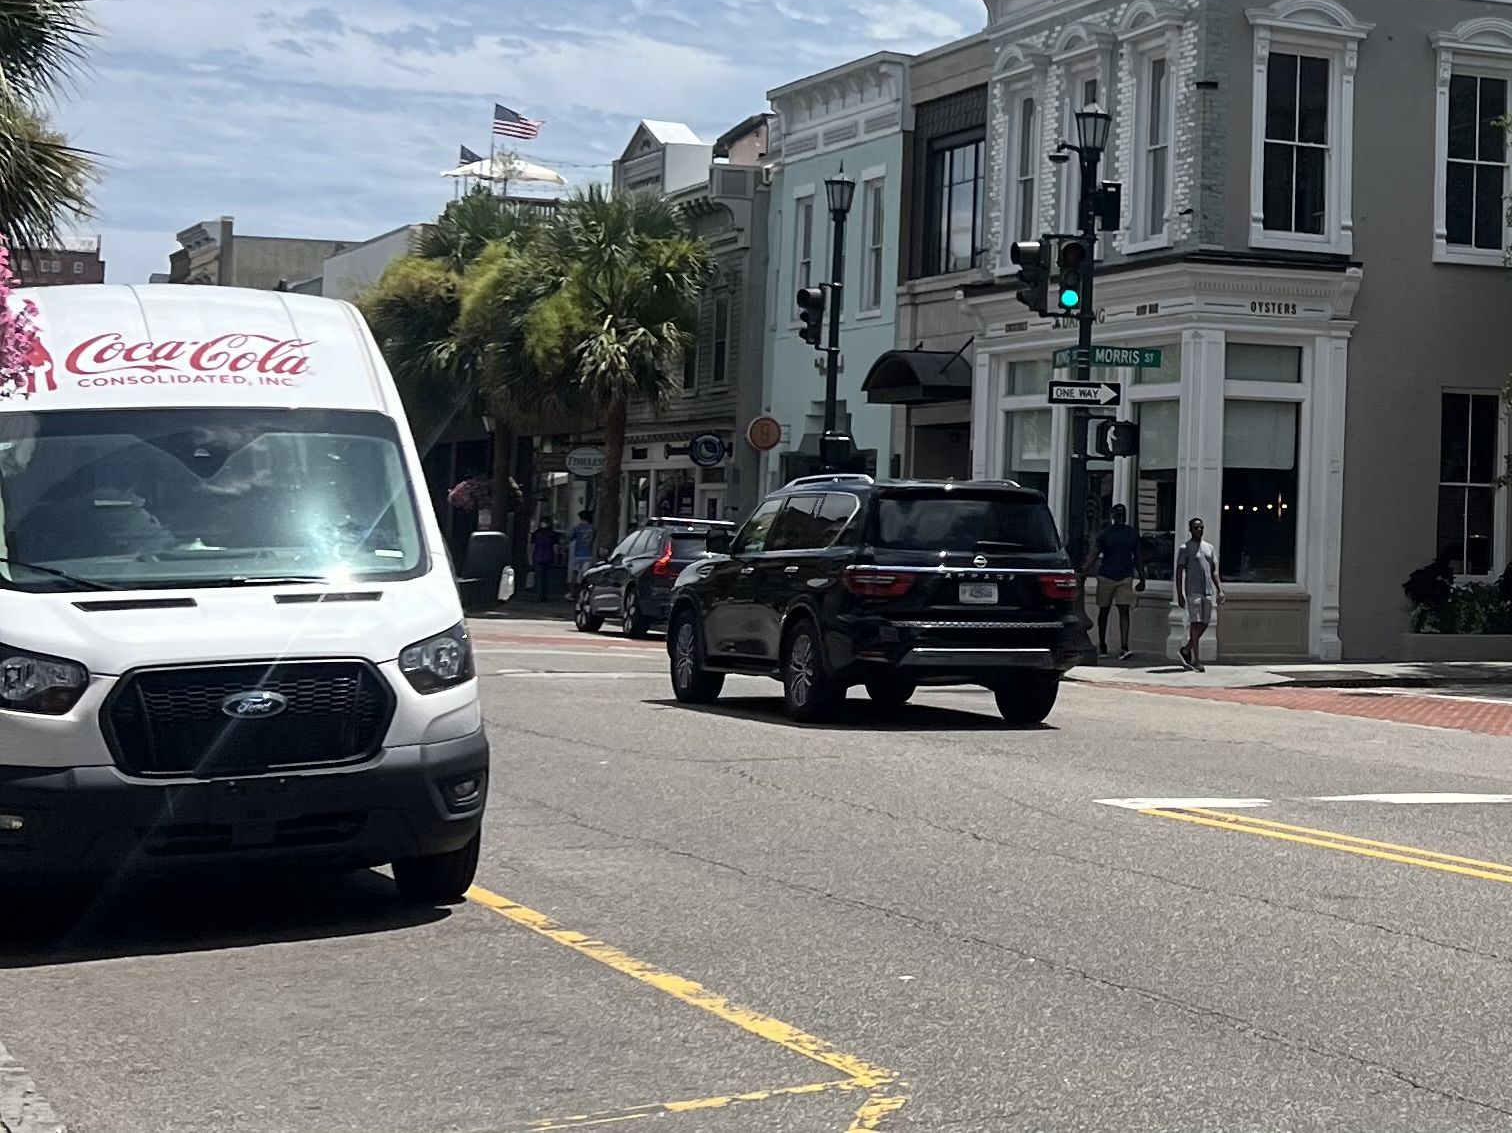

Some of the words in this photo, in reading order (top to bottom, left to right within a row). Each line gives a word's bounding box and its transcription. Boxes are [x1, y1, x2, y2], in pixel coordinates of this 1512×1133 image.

[1250, 301, 1297, 315] OYSTERS
[65, 332, 317, 375] Coca-Cola
[1095, 348, 1140, 364] MORRIS
[1144, 352, 1155, 363] ST
[77, 374, 253, 388] CONSOLIDATED,
[1055, 388, 1075, 398] ONE
[1079, 388, 1099, 399] WAY
